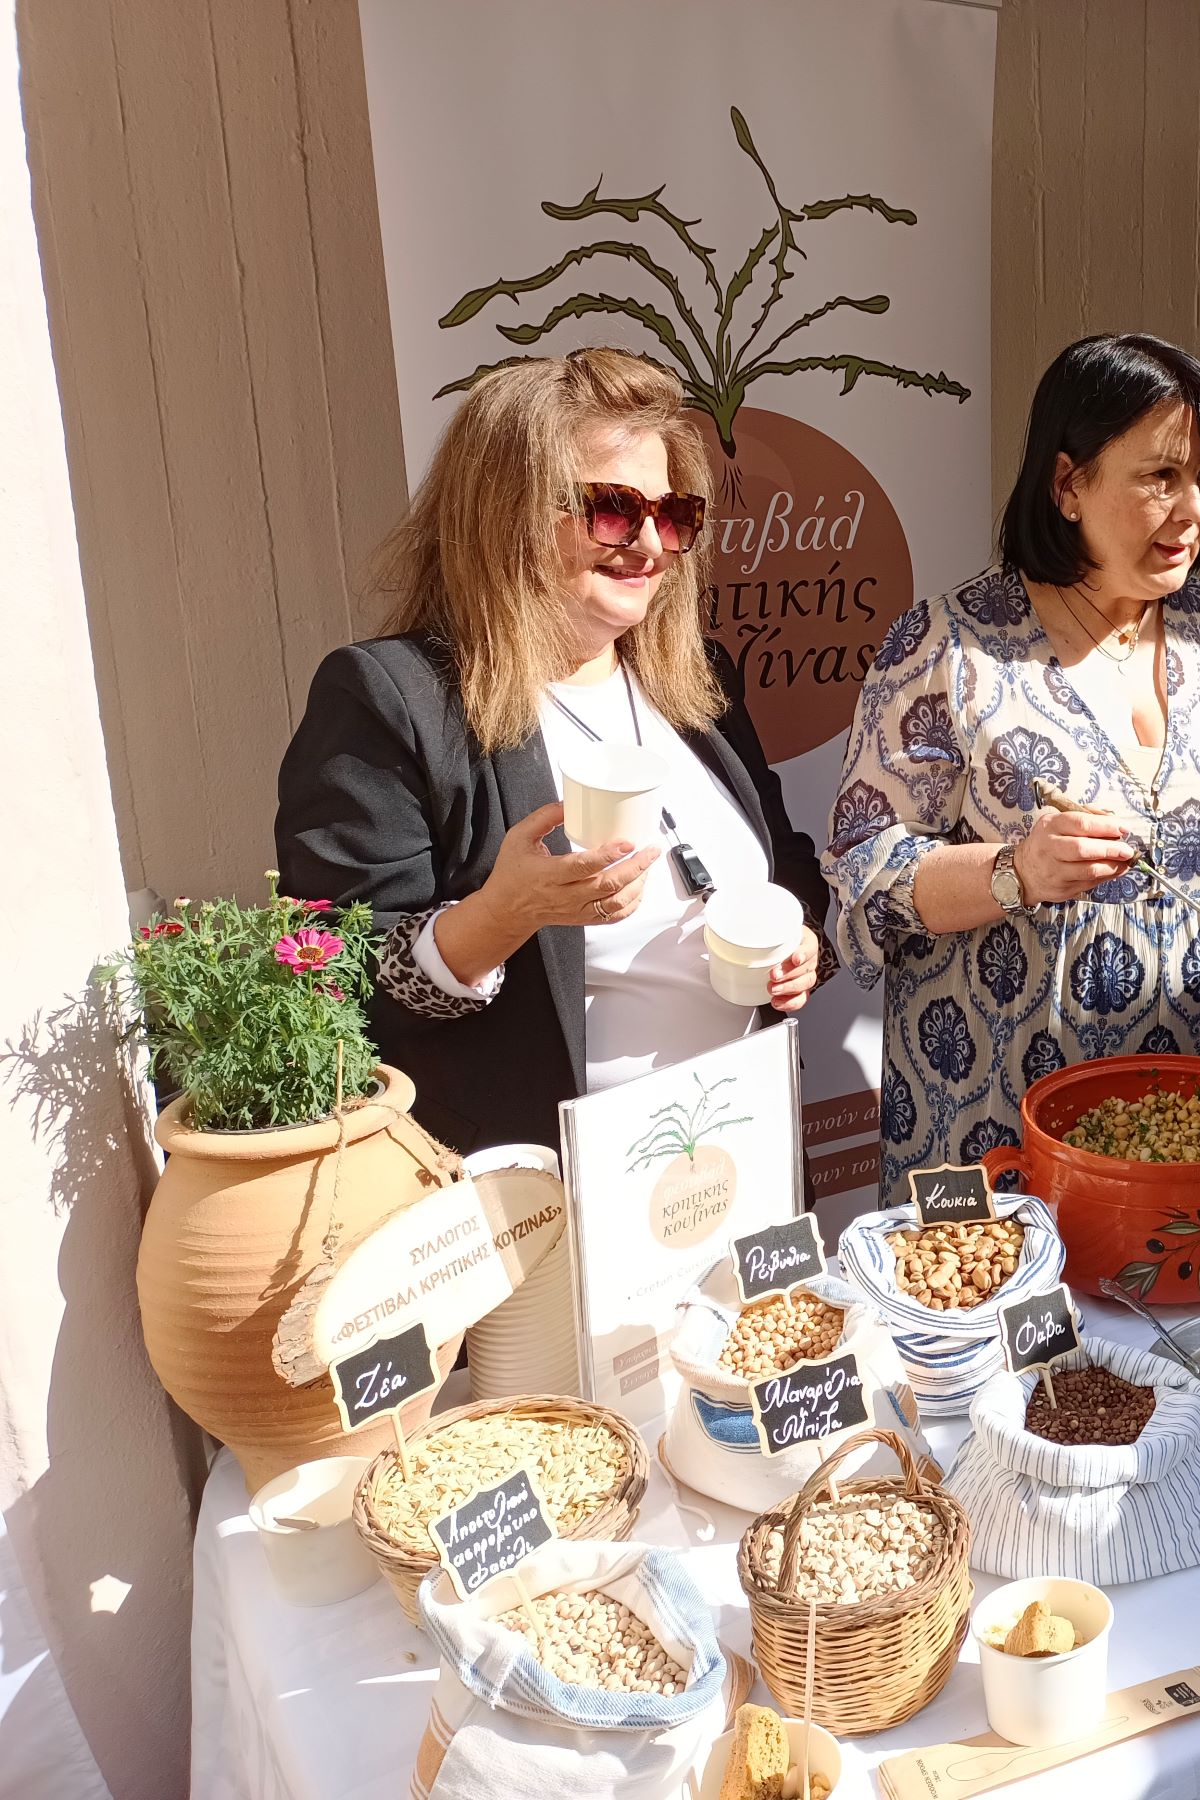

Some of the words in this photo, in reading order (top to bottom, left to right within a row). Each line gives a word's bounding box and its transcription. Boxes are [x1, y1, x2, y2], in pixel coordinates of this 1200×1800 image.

[719, 490, 865, 575] τιβάλ
[701, 560, 878, 630] ητικής
[736, 623, 876, 689] ζίνας
[662, 1179, 728, 1220] κρητικής
[663, 1199, 728, 1238] κουζίνας
[926, 1183, 977, 1209] Κουκιά
[408, 1215, 480, 1267] ΣΥΛΛΟΓΟΣ
[419, 1242, 492, 1299] ΚΡΗΤΙΚΗΣ
[354, 1362, 407, 1410] Ζέα
